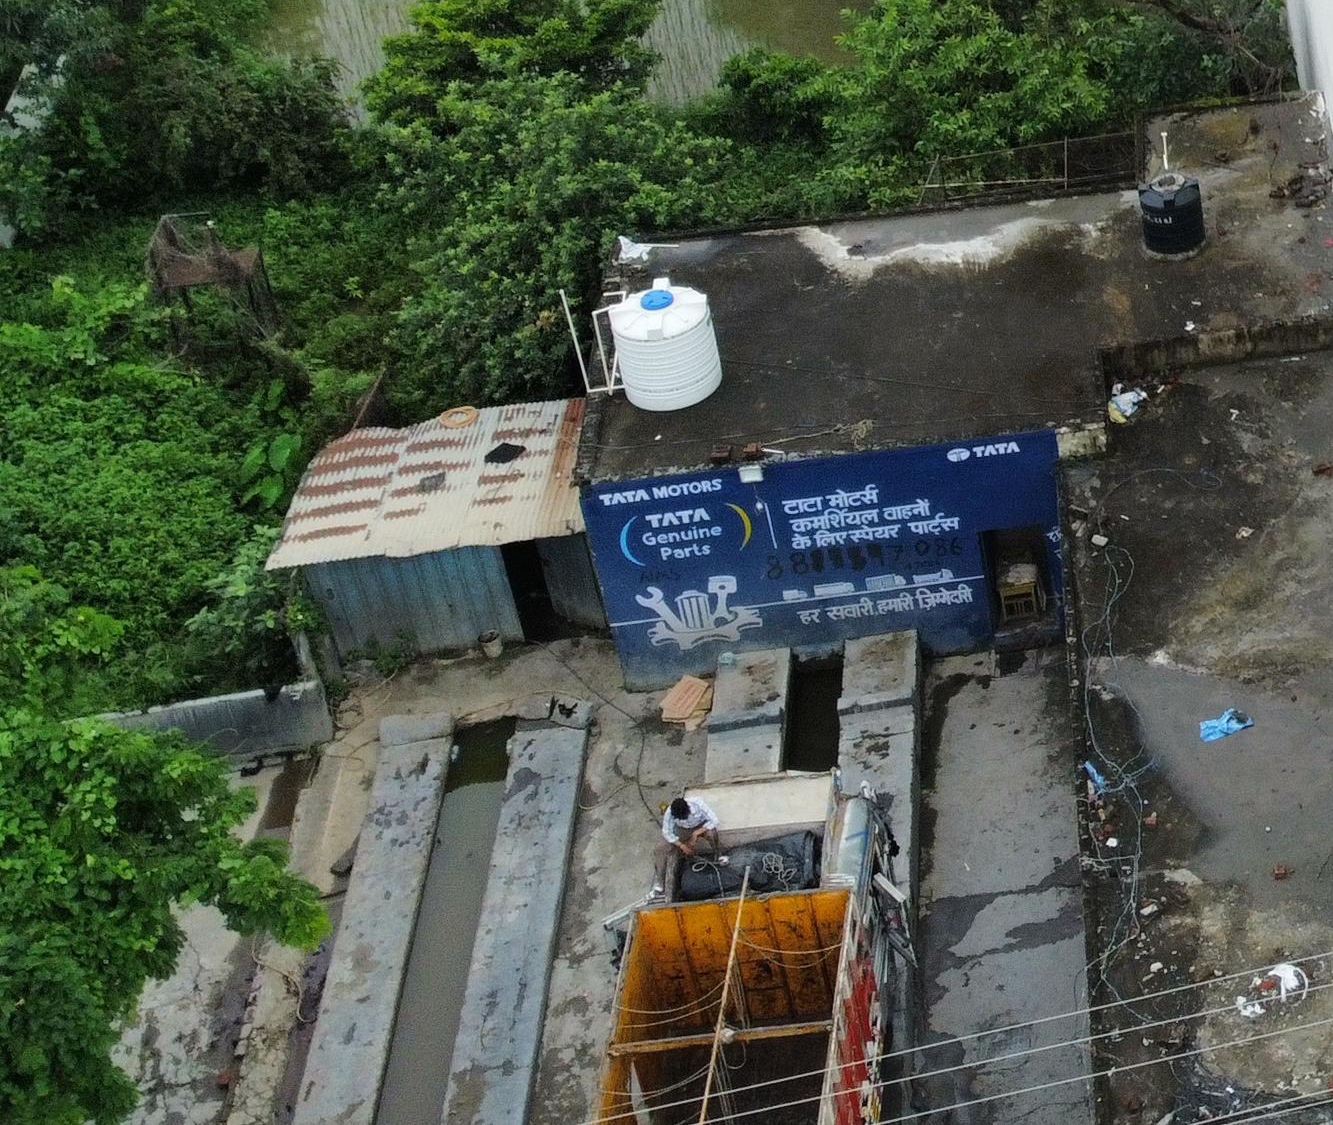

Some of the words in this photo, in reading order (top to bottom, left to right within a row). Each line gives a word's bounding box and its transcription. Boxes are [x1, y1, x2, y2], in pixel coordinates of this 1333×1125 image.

[972, 441, 1020, 458] TATA
[598, 489, 650, 506] TATA
[652, 478, 723, 500] MOTORS
[782, 496, 823, 515] टाटा
[826, 484, 879, 508] मोटर्स
[645, 507, 711, 529] TATA
[883, 499, 930, 520] वाहनों
[642, 525, 723, 546] Genuine
[792, 533, 812, 550] के
[814, 529, 848, 548] लिए
[660, 543, 711, 561] Parts
[797, 609, 821, 625] हर
